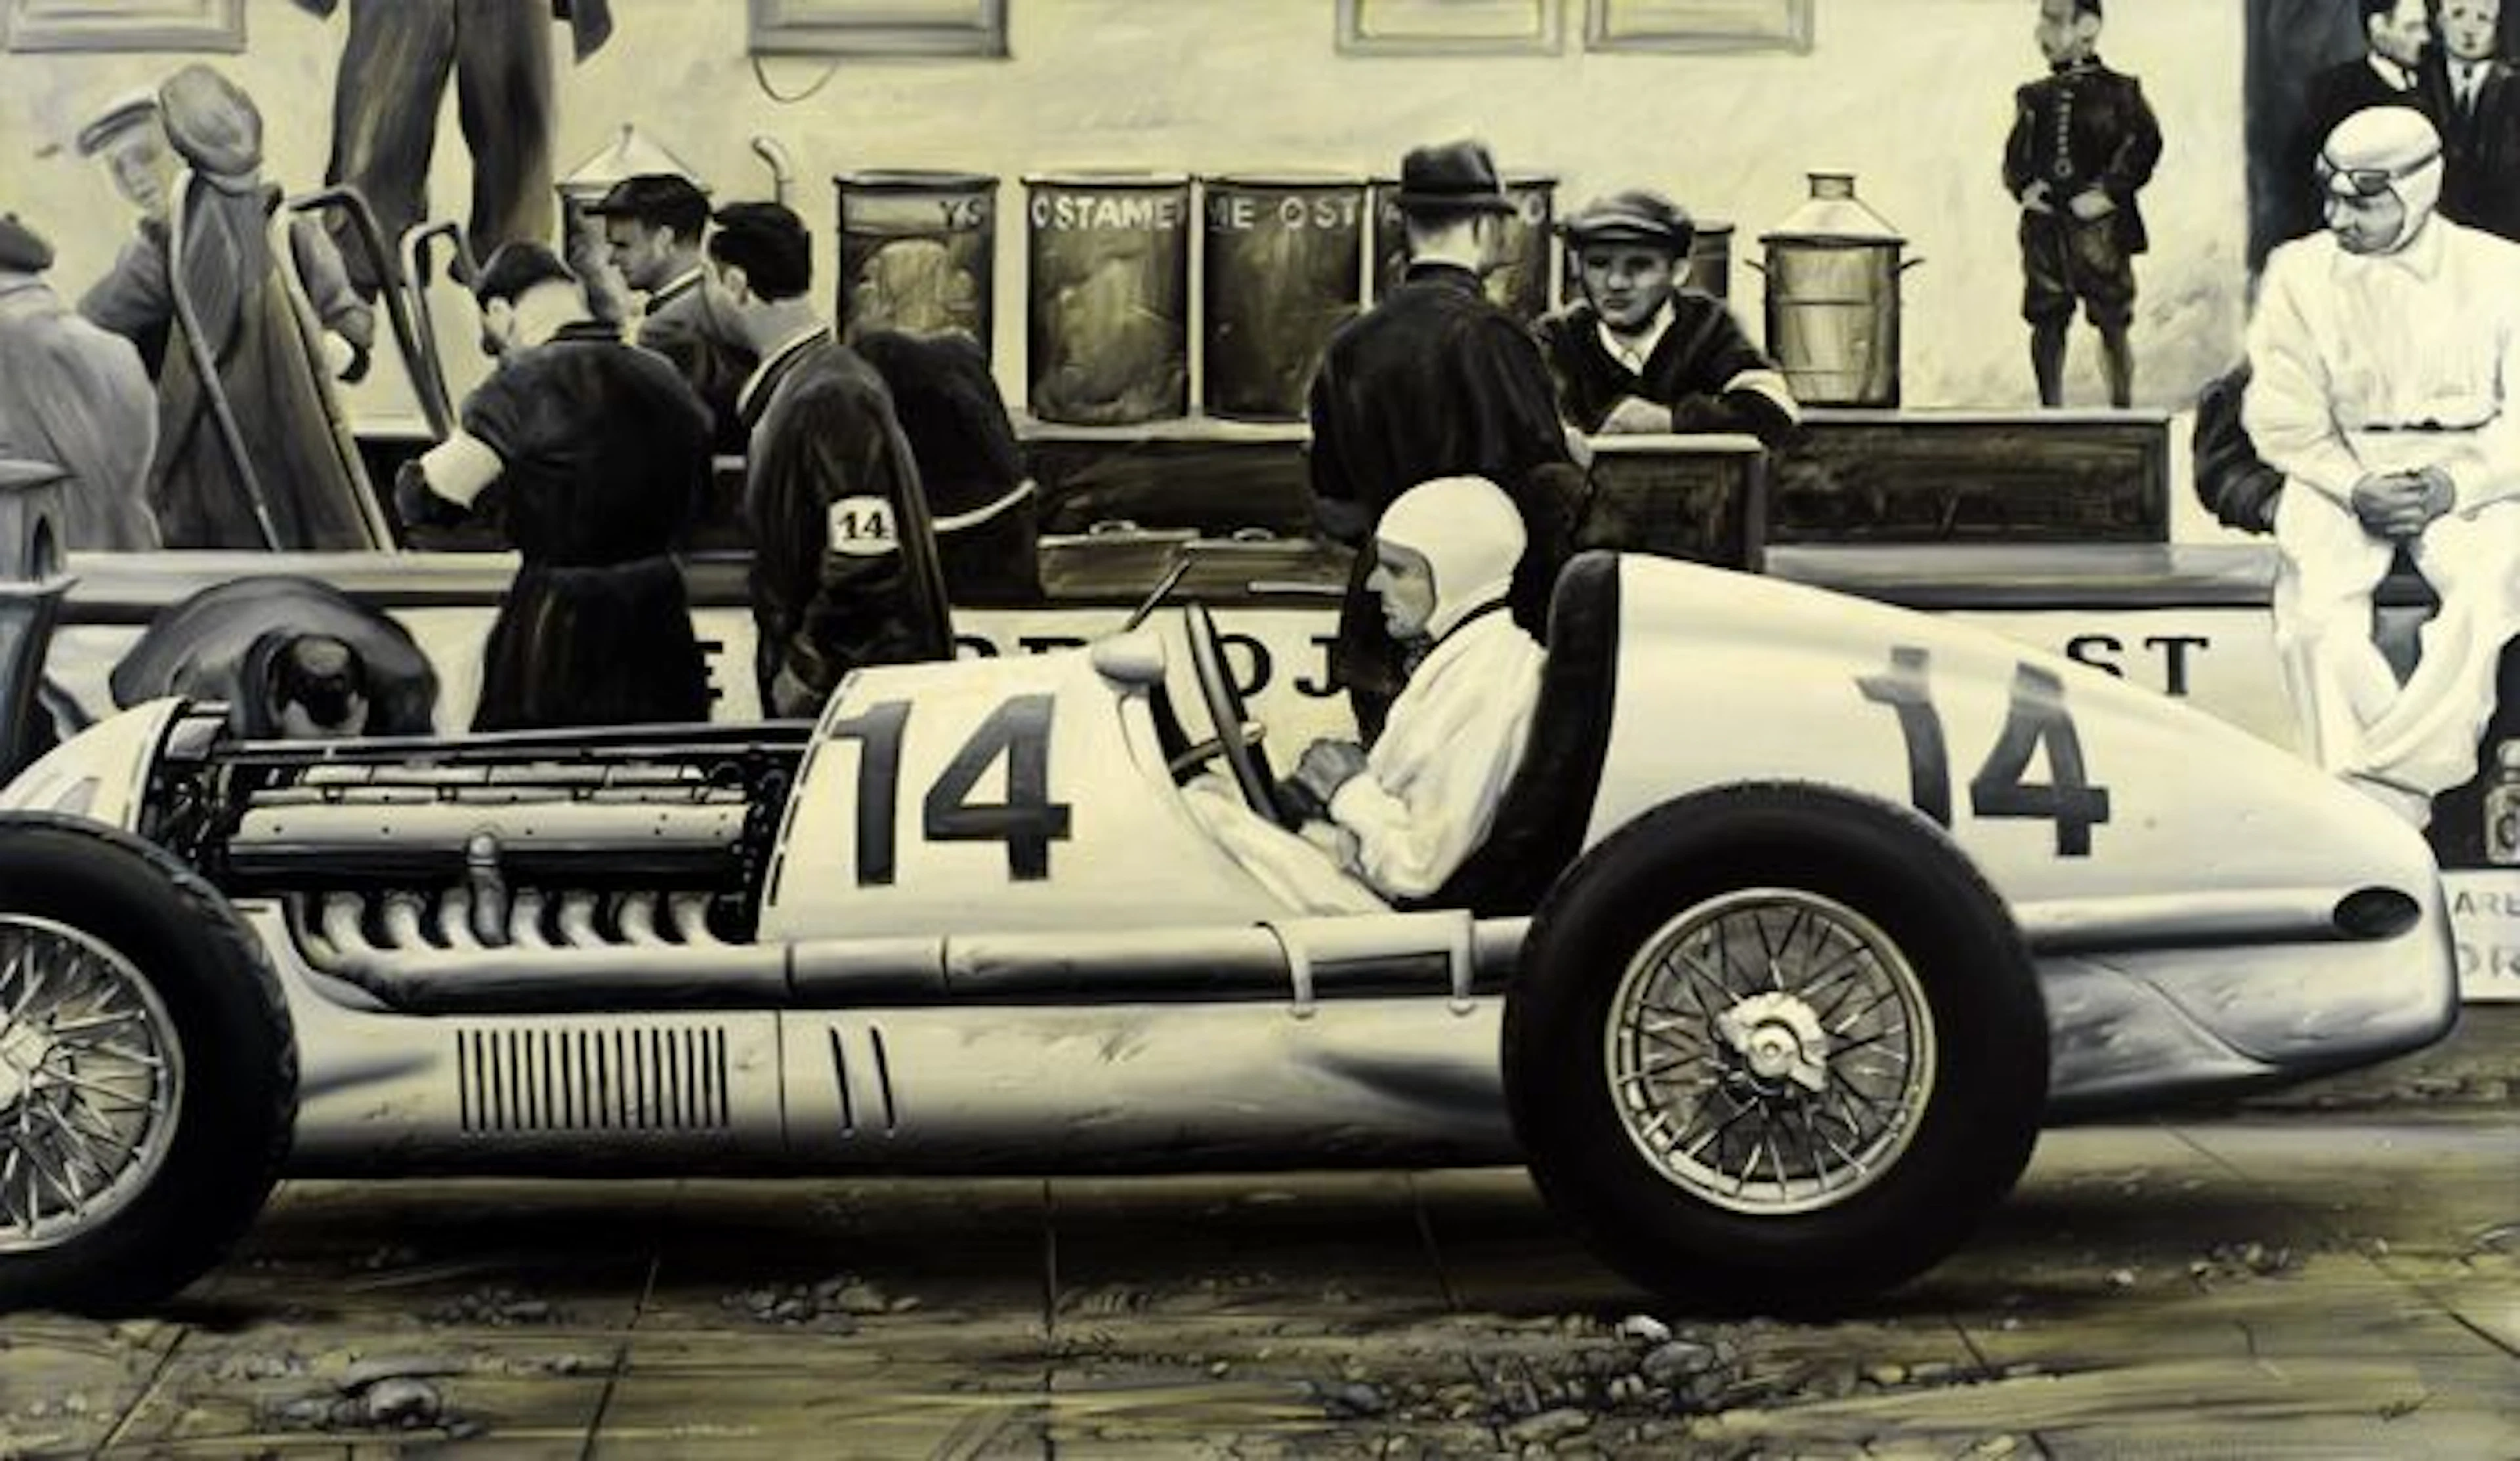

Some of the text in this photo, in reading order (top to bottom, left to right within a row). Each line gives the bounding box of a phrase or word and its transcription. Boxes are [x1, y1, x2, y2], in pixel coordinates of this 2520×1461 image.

[840, 511, 887, 540] 14
[2066, 634, 2210, 696] ST
[831, 693, 1072, 885] 14
[1855, 646, 2110, 856] 14
